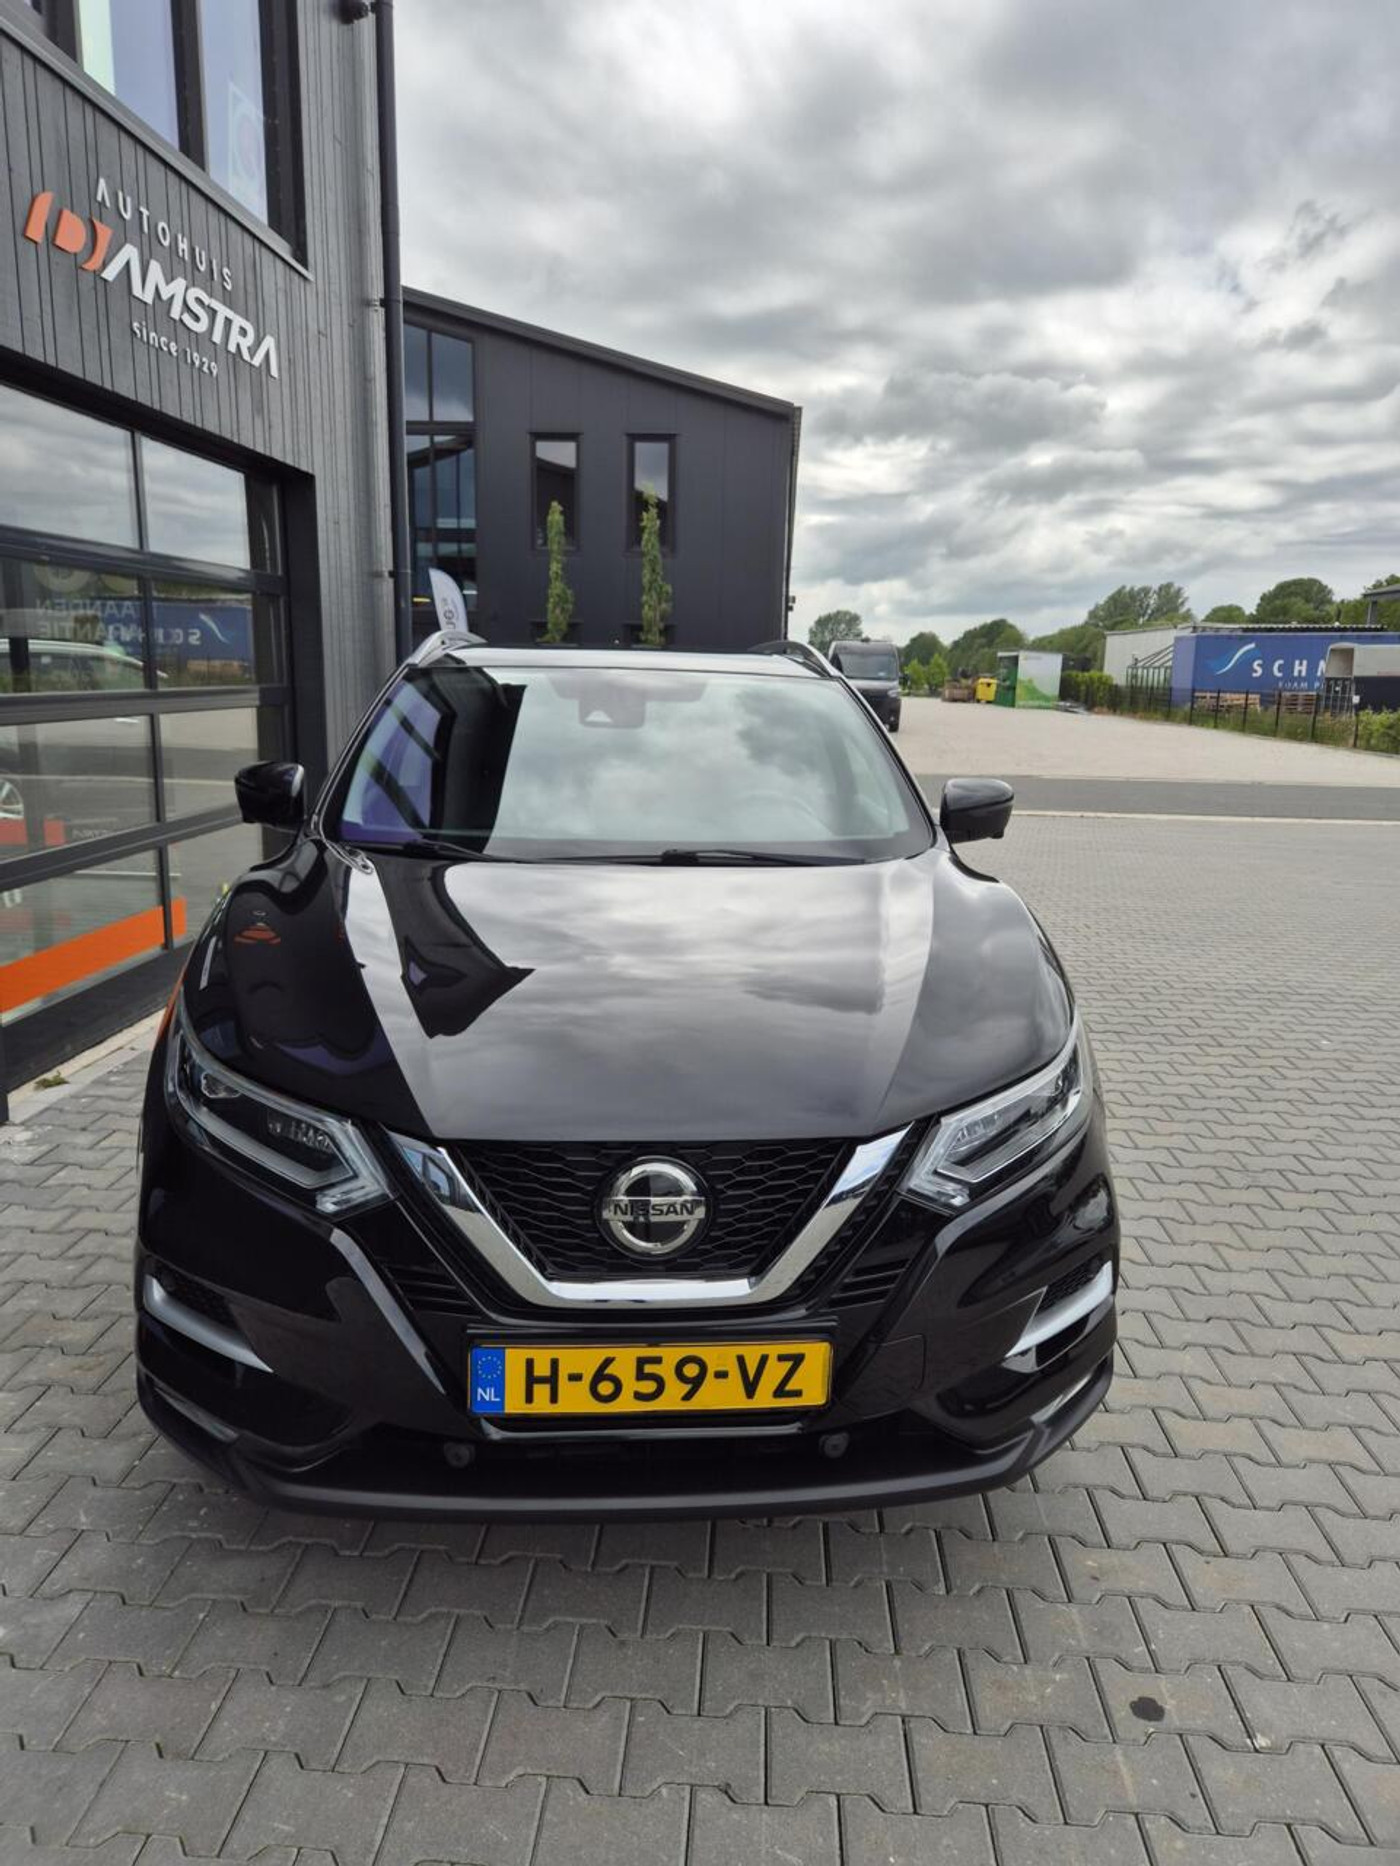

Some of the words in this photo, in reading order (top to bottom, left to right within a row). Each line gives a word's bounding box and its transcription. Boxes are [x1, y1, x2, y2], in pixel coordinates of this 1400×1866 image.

[96, 177, 233, 291] AUTOHUIS
[132, 320, 178, 358] since
[186, 347, 219, 378] 1929
[612, 1200, 696, 1217] NISSAN
[476, 1387, 501, 1402] NL
[524, 1352, 806, 1405] H-659-VZ
